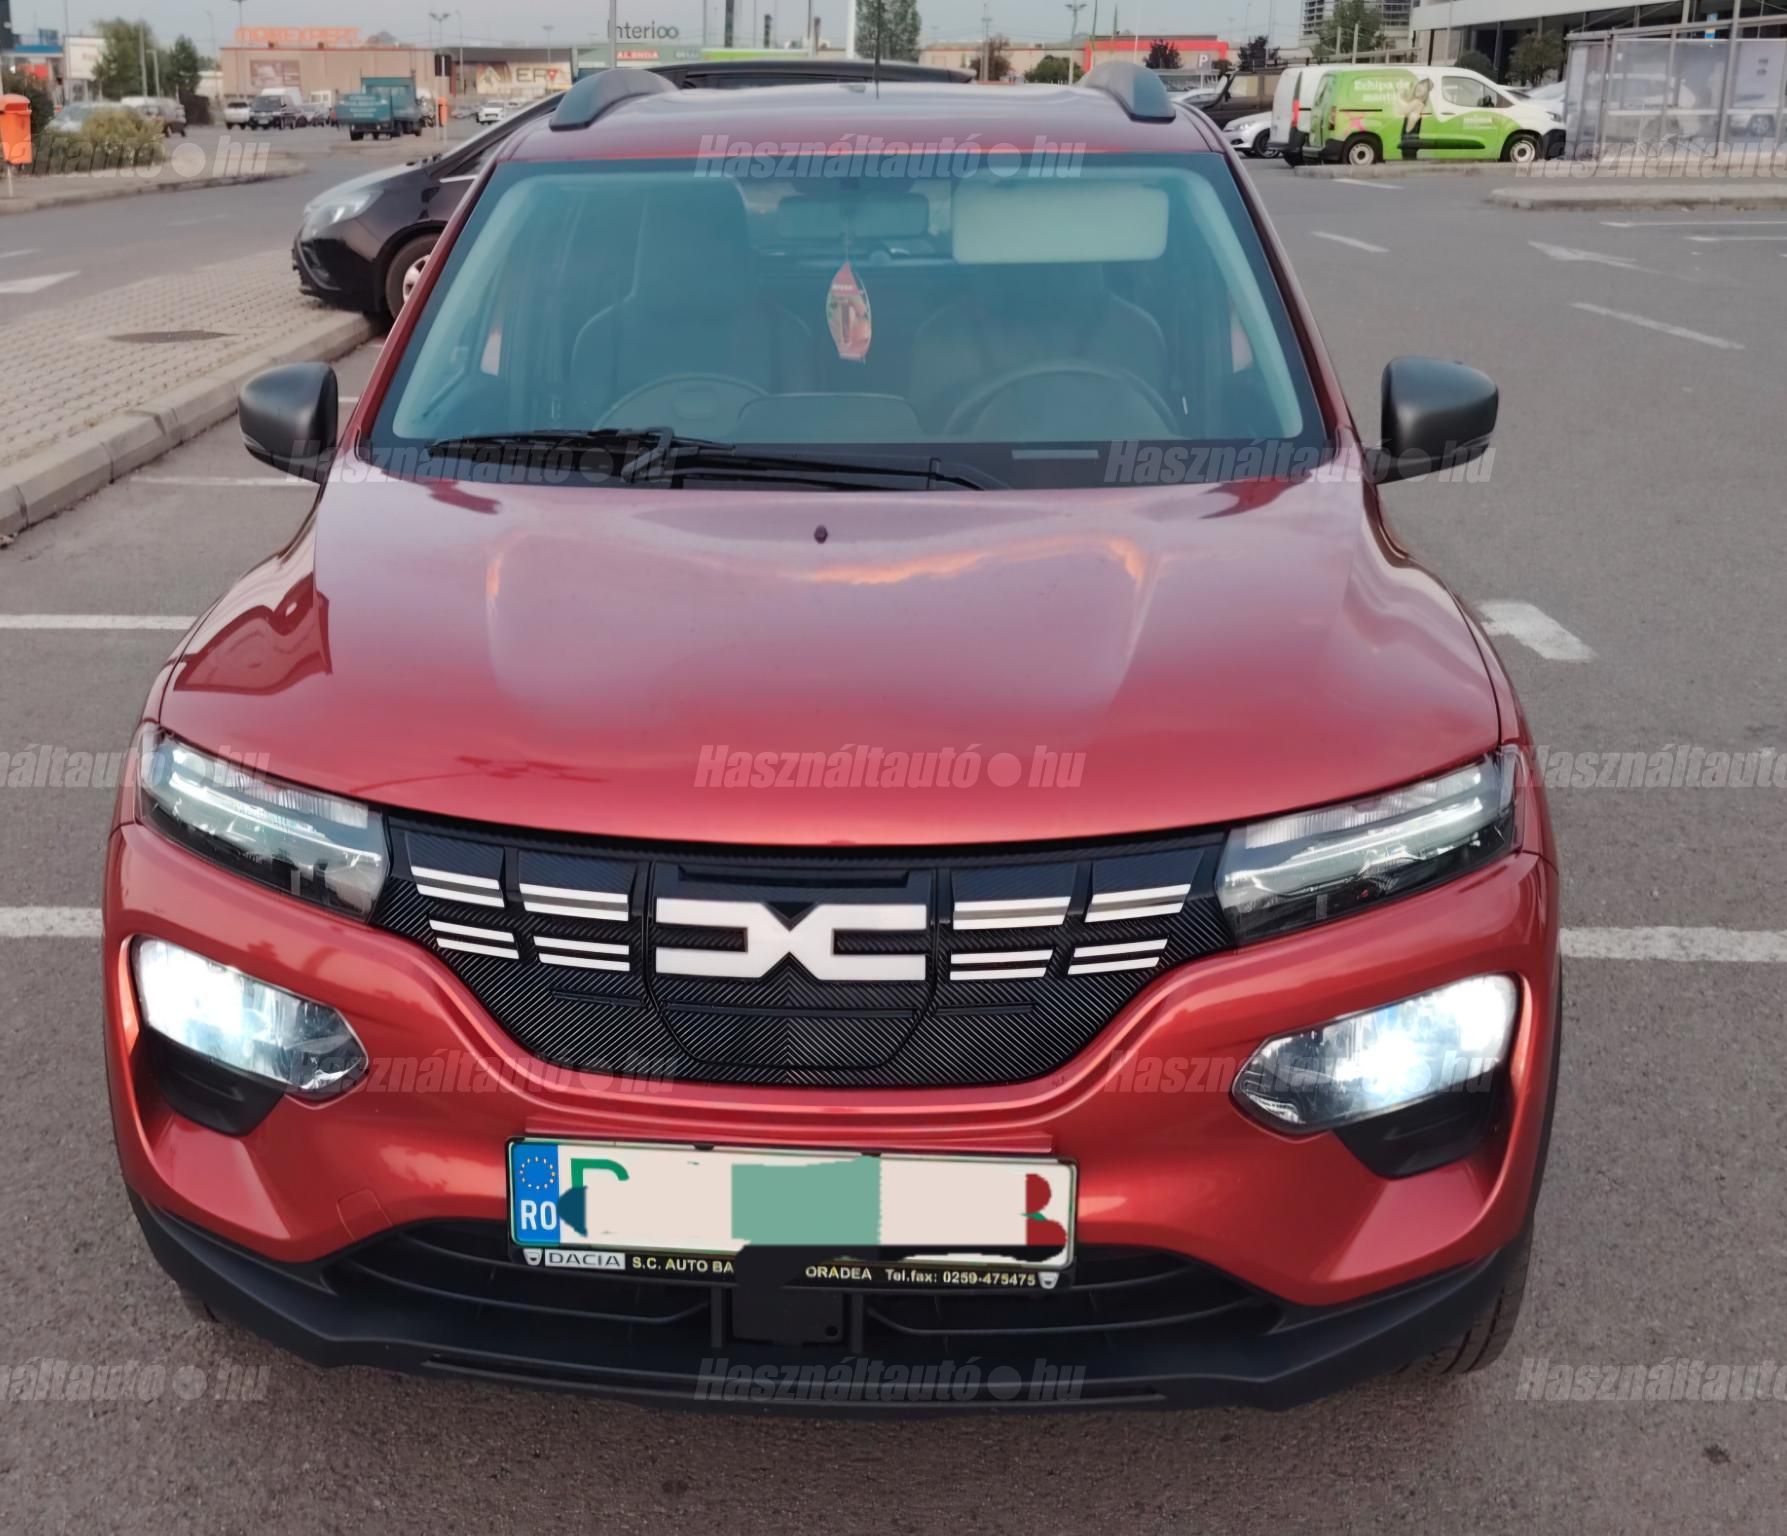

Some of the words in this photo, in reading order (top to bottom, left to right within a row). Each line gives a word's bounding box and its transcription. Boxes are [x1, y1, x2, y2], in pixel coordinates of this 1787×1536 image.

[520, 1199, 557, 1231] RO
[549, 1252, 621, 1267] DACIA
[632, 1256, 661, 1270] S.C.
[665, 1258, 708, 1272] AUTO
[712, 1260, 735, 1274] BA
[805, 1265, 872, 1281] ORADEA
